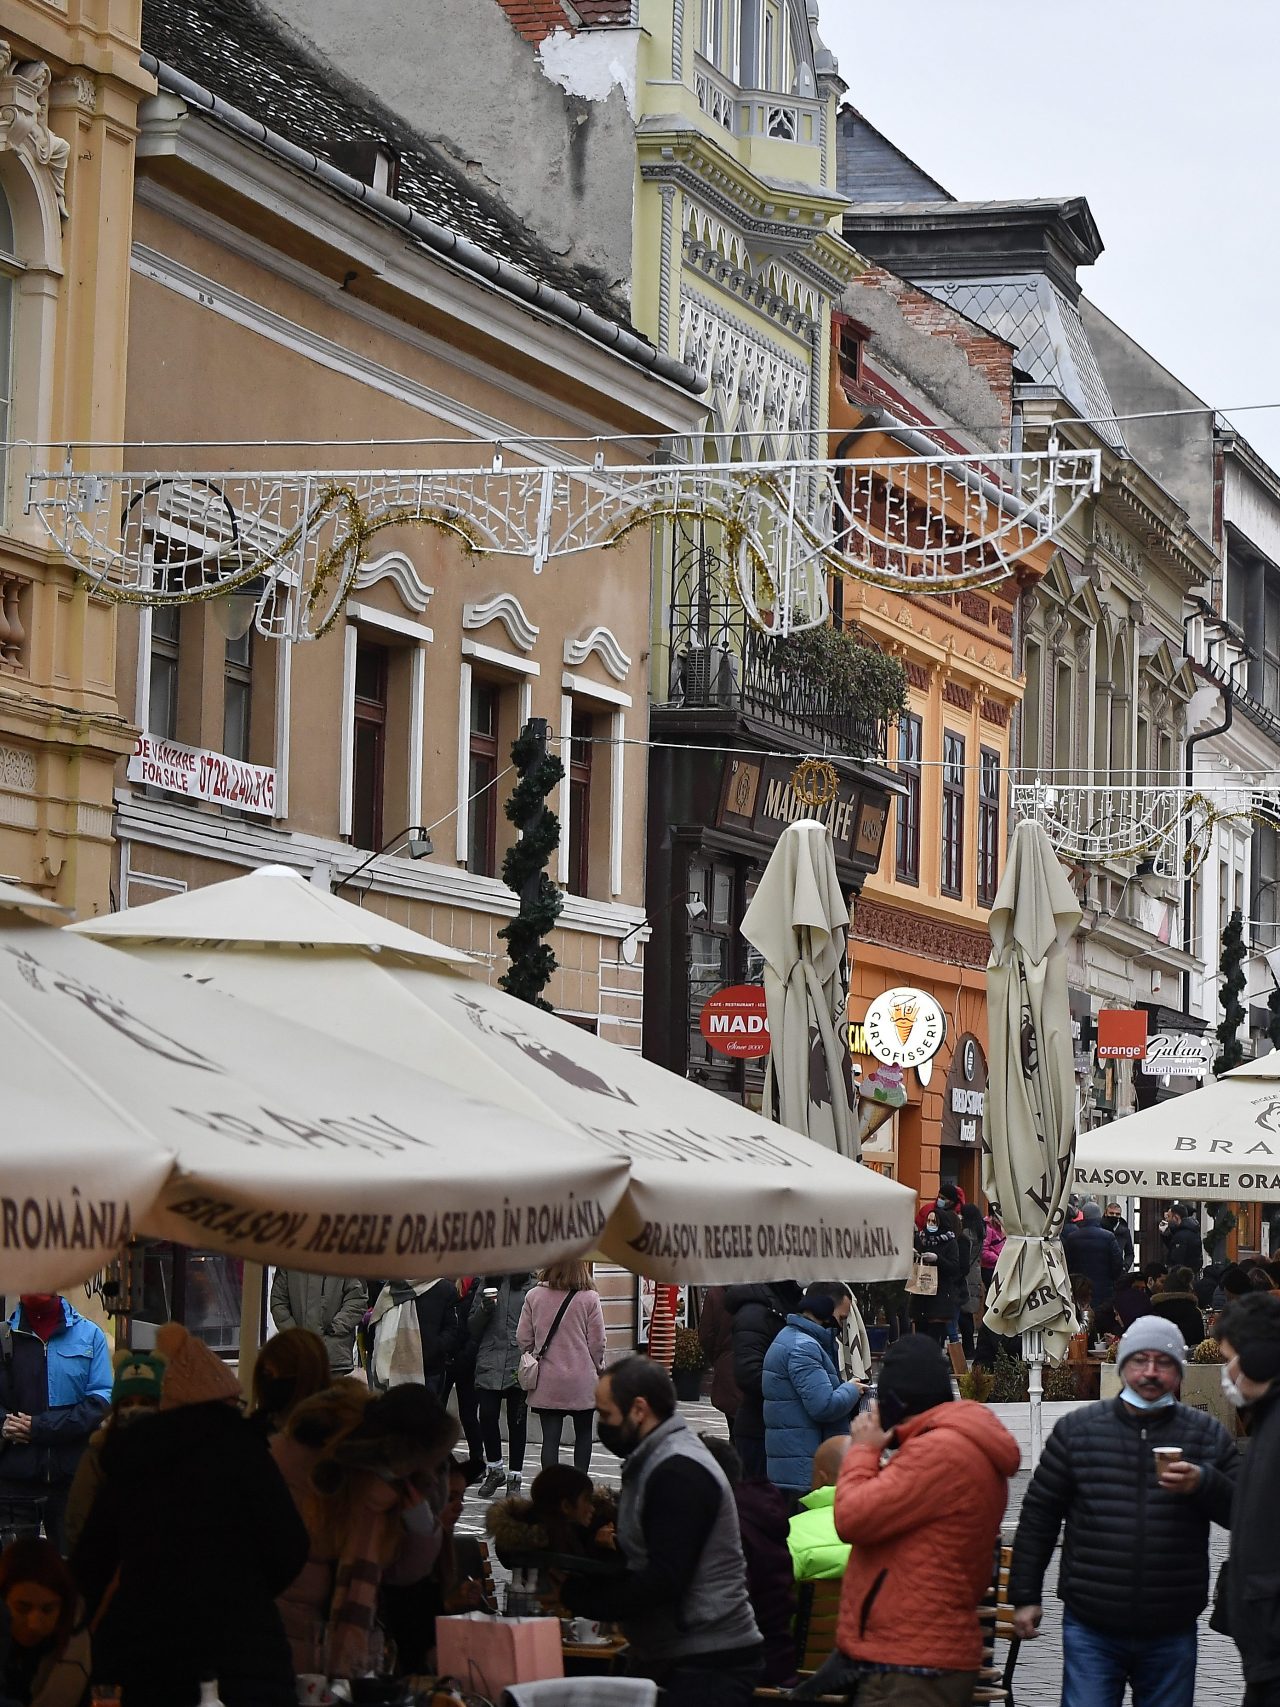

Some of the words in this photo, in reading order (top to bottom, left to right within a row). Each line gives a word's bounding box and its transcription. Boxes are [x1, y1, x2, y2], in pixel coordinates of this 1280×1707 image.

[142, 761, 162, 785] FOR
[164, 769, 189, 792] SALE
[869, 1011, 937, 1062] CARTOFISSERIE
[1100, 1045, 1141, 1058] orange
[1074, 1167, 1148, 1188] RAȘOV.
[1155, 1170, 1230, 1189] REGELE
[0, 1185, 133, 1251] ROMÂNIA
[304, 1212, 393, 1255] REGELE
[395, 1208, 498, 1264] ORAȘELOR
[501, 1197, 522, 1248] ÎN
[704, 1224, 754, 1260] REGELE
[757, 1223, 818, 1262] ORAȘELOR
